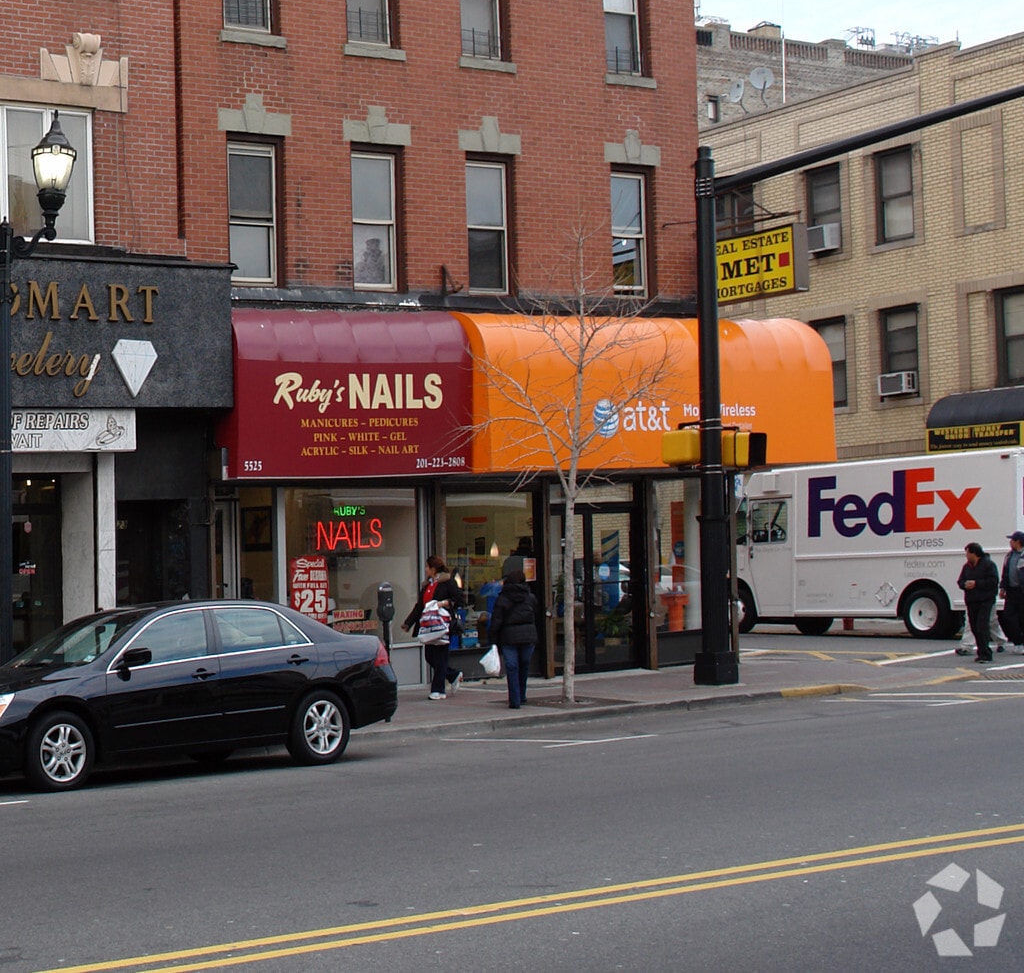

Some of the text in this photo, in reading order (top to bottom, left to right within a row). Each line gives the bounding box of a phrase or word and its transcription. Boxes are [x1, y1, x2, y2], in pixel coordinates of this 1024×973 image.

[716, 232, 789, 256] EAL ESTATE
[717, 277, 787, 298] ORTGAGES
[273, 372, 443, 414] Ruby's NAILS
[23, 413, 90, 430] REPAIRS
[301, 418, 359, 428] MANICURES
[369, 417, 418, 427] PEDICURES
[623, 401, 671, 432] at&t
[314, 433, 338, 442] PINK
[348, 432, 380, 442] WHITE
[390, 431, 407, 441] GEL
[301, 446, 339, 456] ACRYLIC
[349, 446, 368, 455] SILK
[378, 445, 400, 455] NAIL
[401, 444, 419, 454] ART
[244, 460, 263, 472] 5525
[808, 467, 982, 538] FedEx
[333, 506, 366, 516] RUBY'S
[316, 518, 383, 550] NAILS
[904, 536, 944, 549] Express
[904, 559, 945, 569] fedex.com
[295, 589, 327, 613] $25
[334, 610, 363, 619] WAXING
